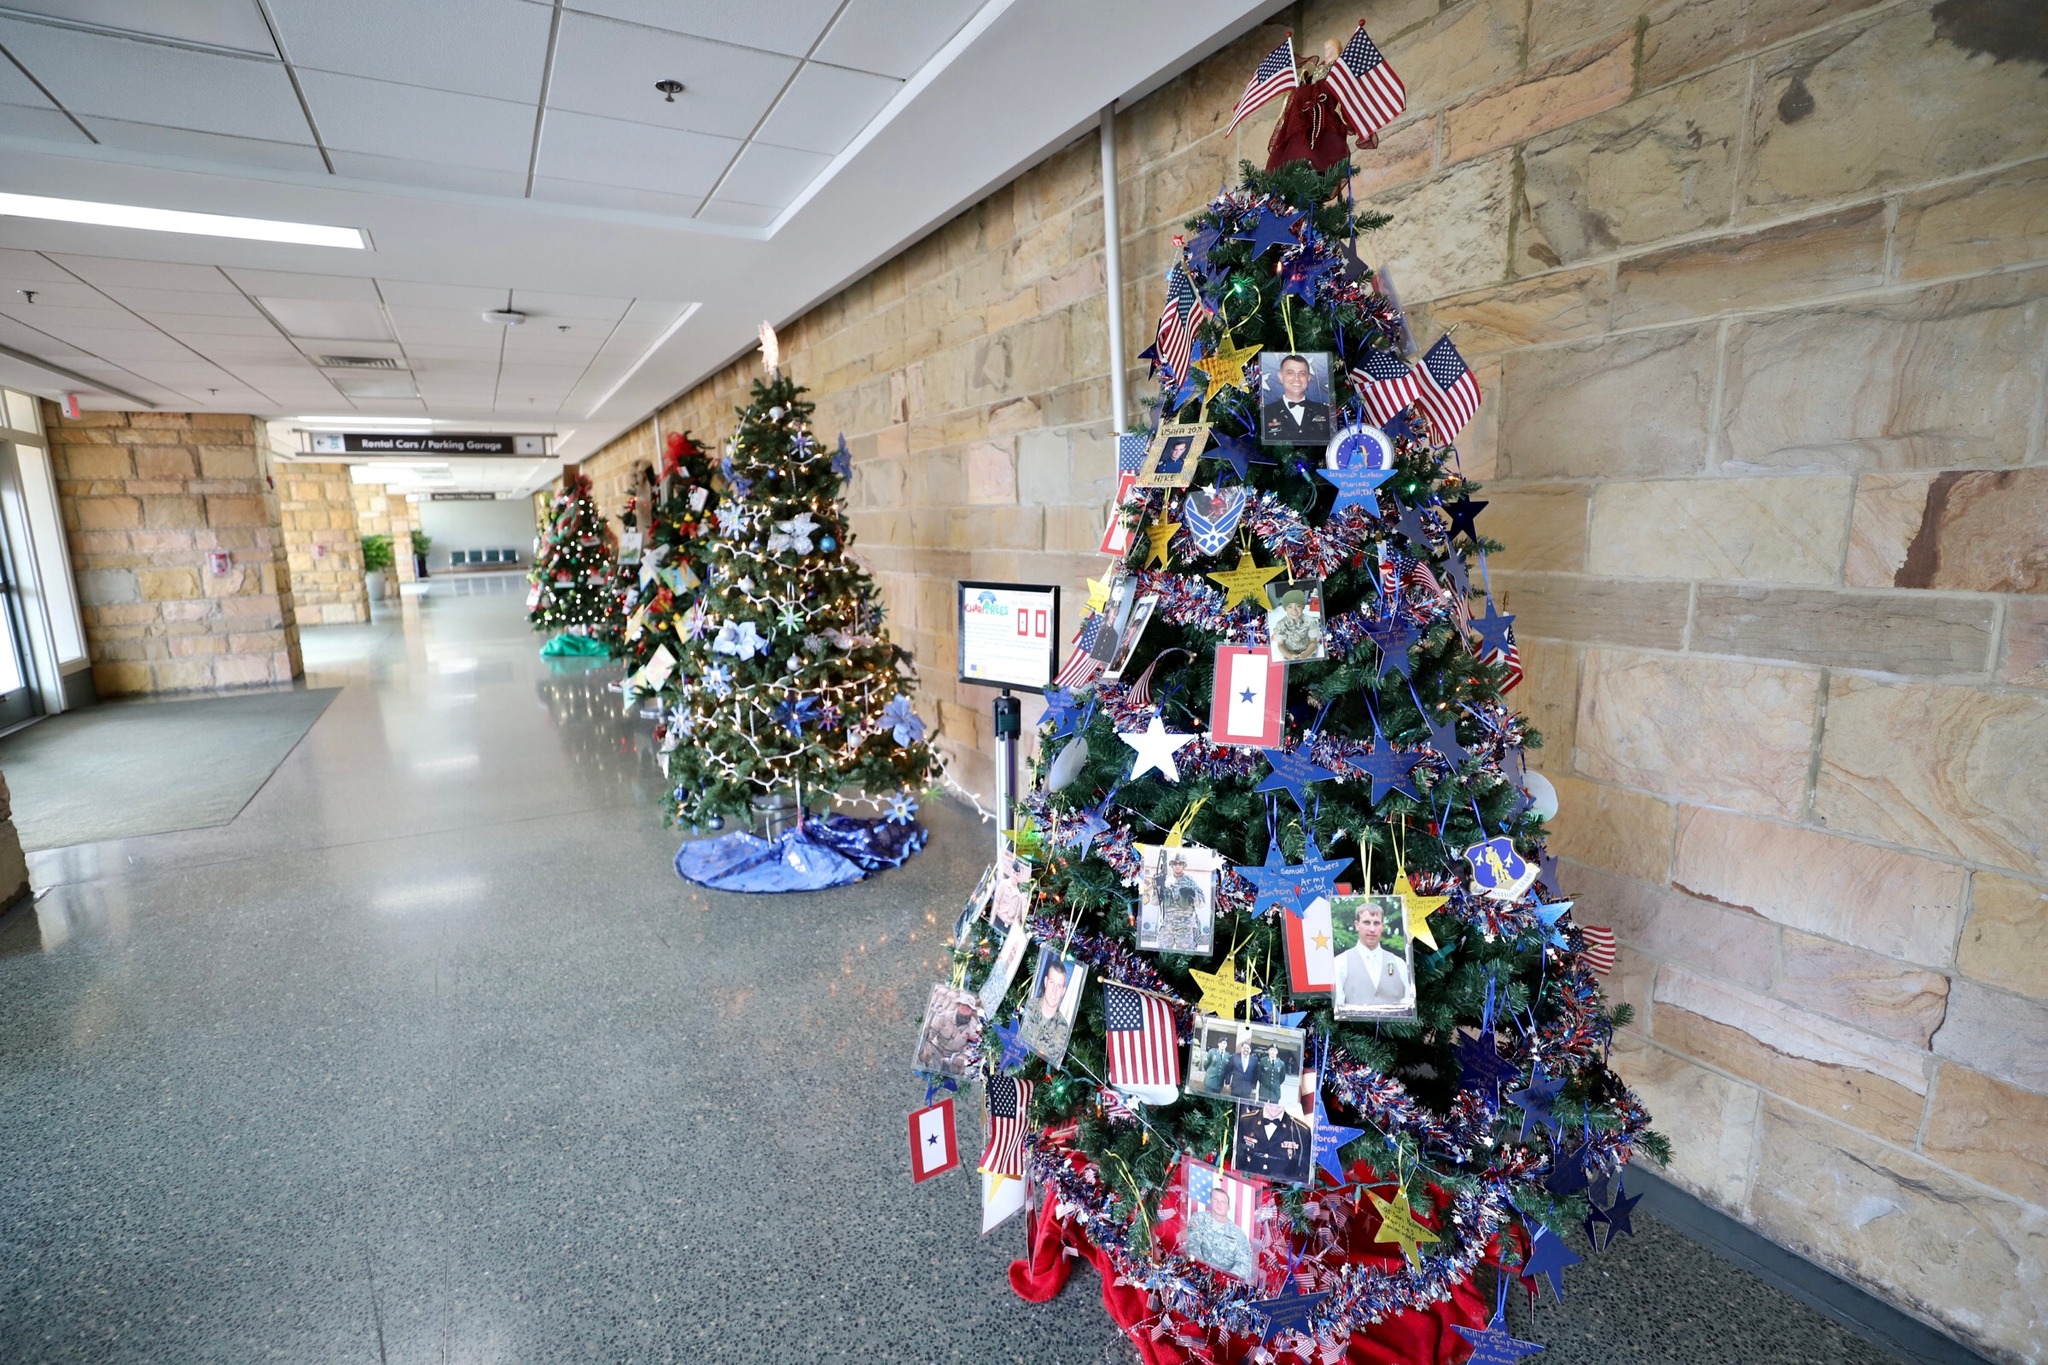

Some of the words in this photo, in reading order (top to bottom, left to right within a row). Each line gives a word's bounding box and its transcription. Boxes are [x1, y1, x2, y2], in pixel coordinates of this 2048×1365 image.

[361, 438, 394, 449] Rental
[396, 439, 420, 450] Cars
[420, 439, 426, 450] /
[428, 440, 465, 452] Parking
[466, 441, 503, 451] Garage
[1350, 463, 1363, 472] Sgt
[1154, 474, 1176, 483] HYKE
[1280, 864, 1308, 875] Samuel
[1313, 861, 1340, 872] Powers
[1258, 879, 1274, 887] Air
[1300, 876, 1325, 886] Army
[1258, 889, 1293, 898] Clinton
[1300, 884, 1326, 895] Clinton
[1473, 1339, 1490, 1349] Air
[1494, 1345, 1521, 1356] Force
[1489, 1335, 1532, 1350] Campbell
